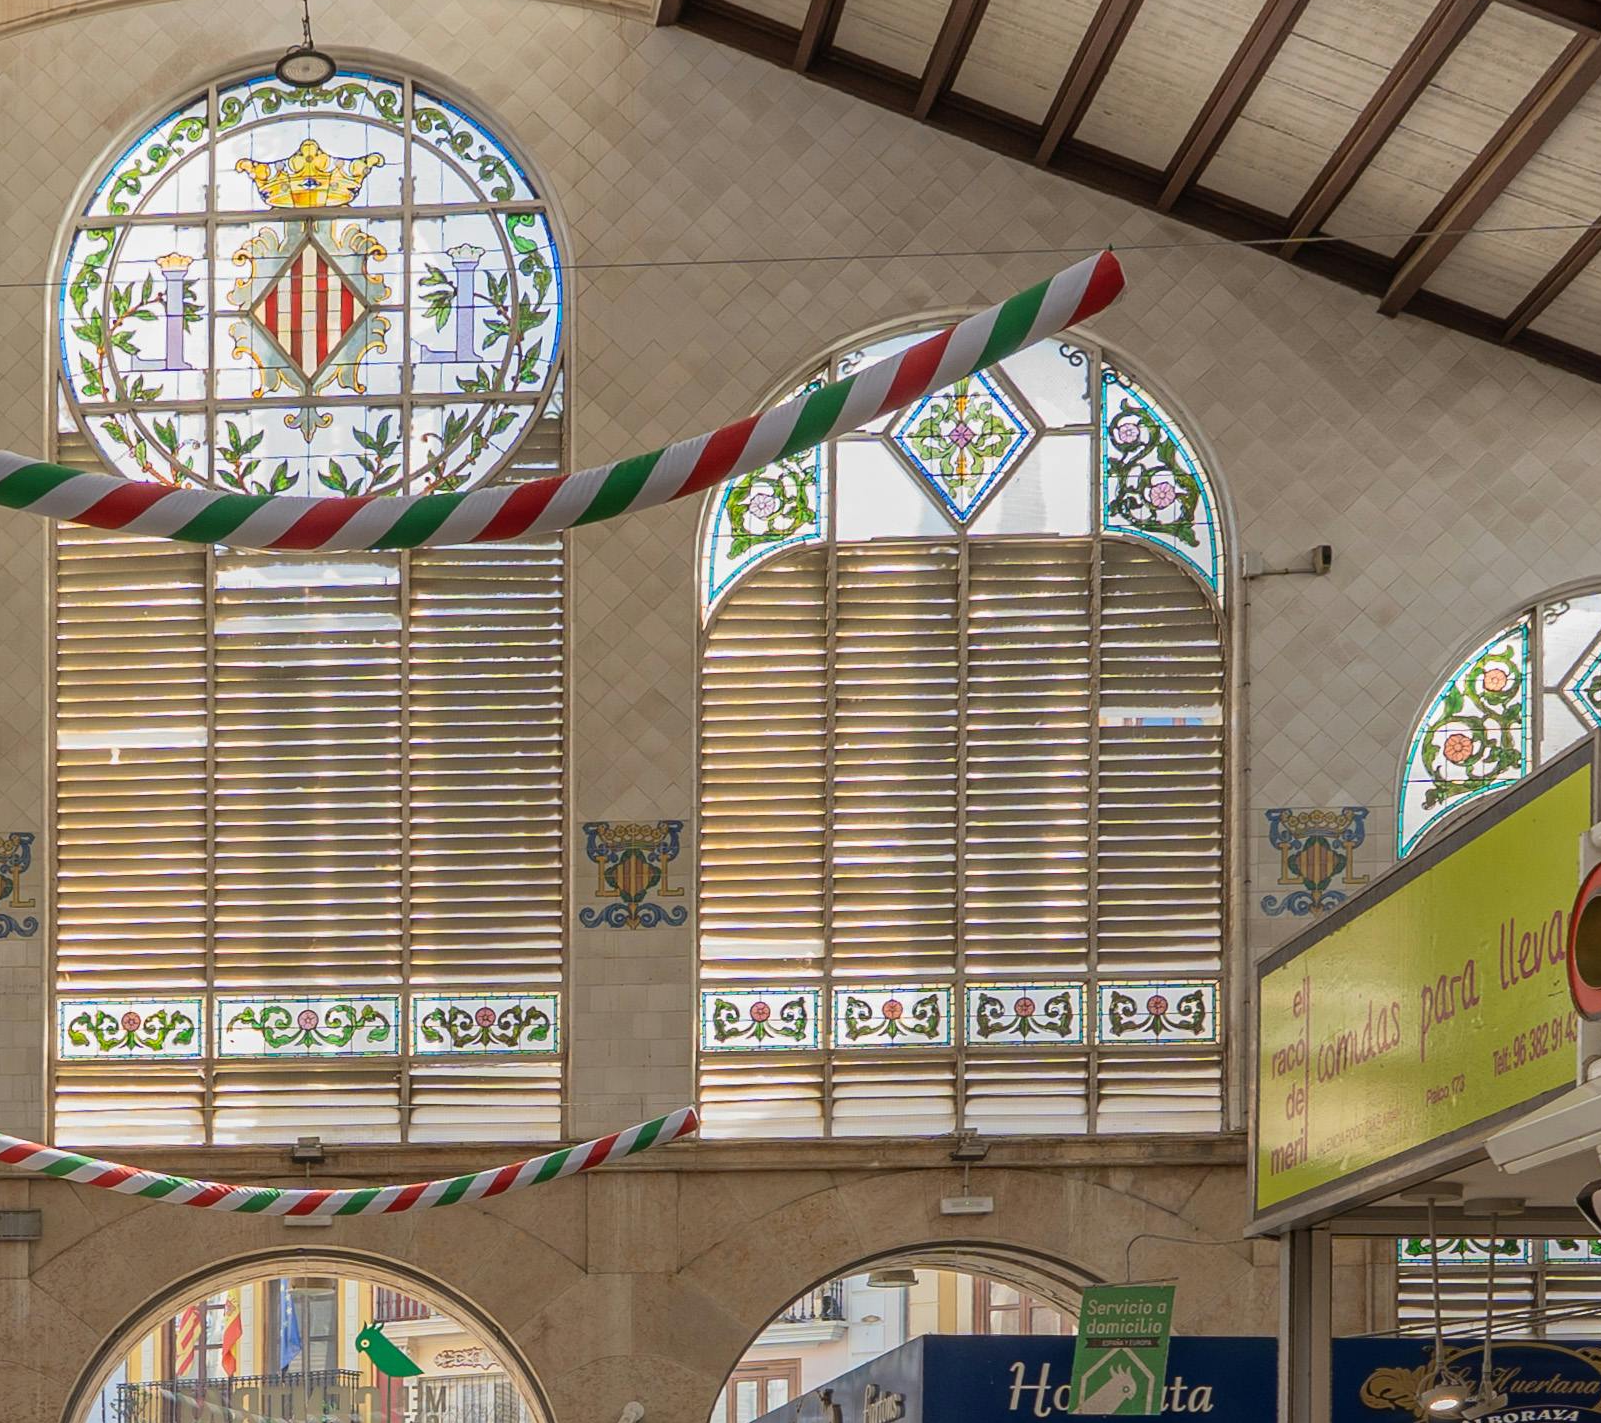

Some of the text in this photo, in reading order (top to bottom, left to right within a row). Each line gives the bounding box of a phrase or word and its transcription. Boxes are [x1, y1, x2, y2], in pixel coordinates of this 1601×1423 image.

[1316, 909, 1572, 1084] comidas para lleva
[1512, 1032, 1528, 1068] 96
[1528, 1023, 1550, 1060] 382
[1087, 1298, 1168, 1317] Servicio a
[1086, 1318, 1163, 1335] domicilio
[1491, 1367, 1601, 1395] Huertana
